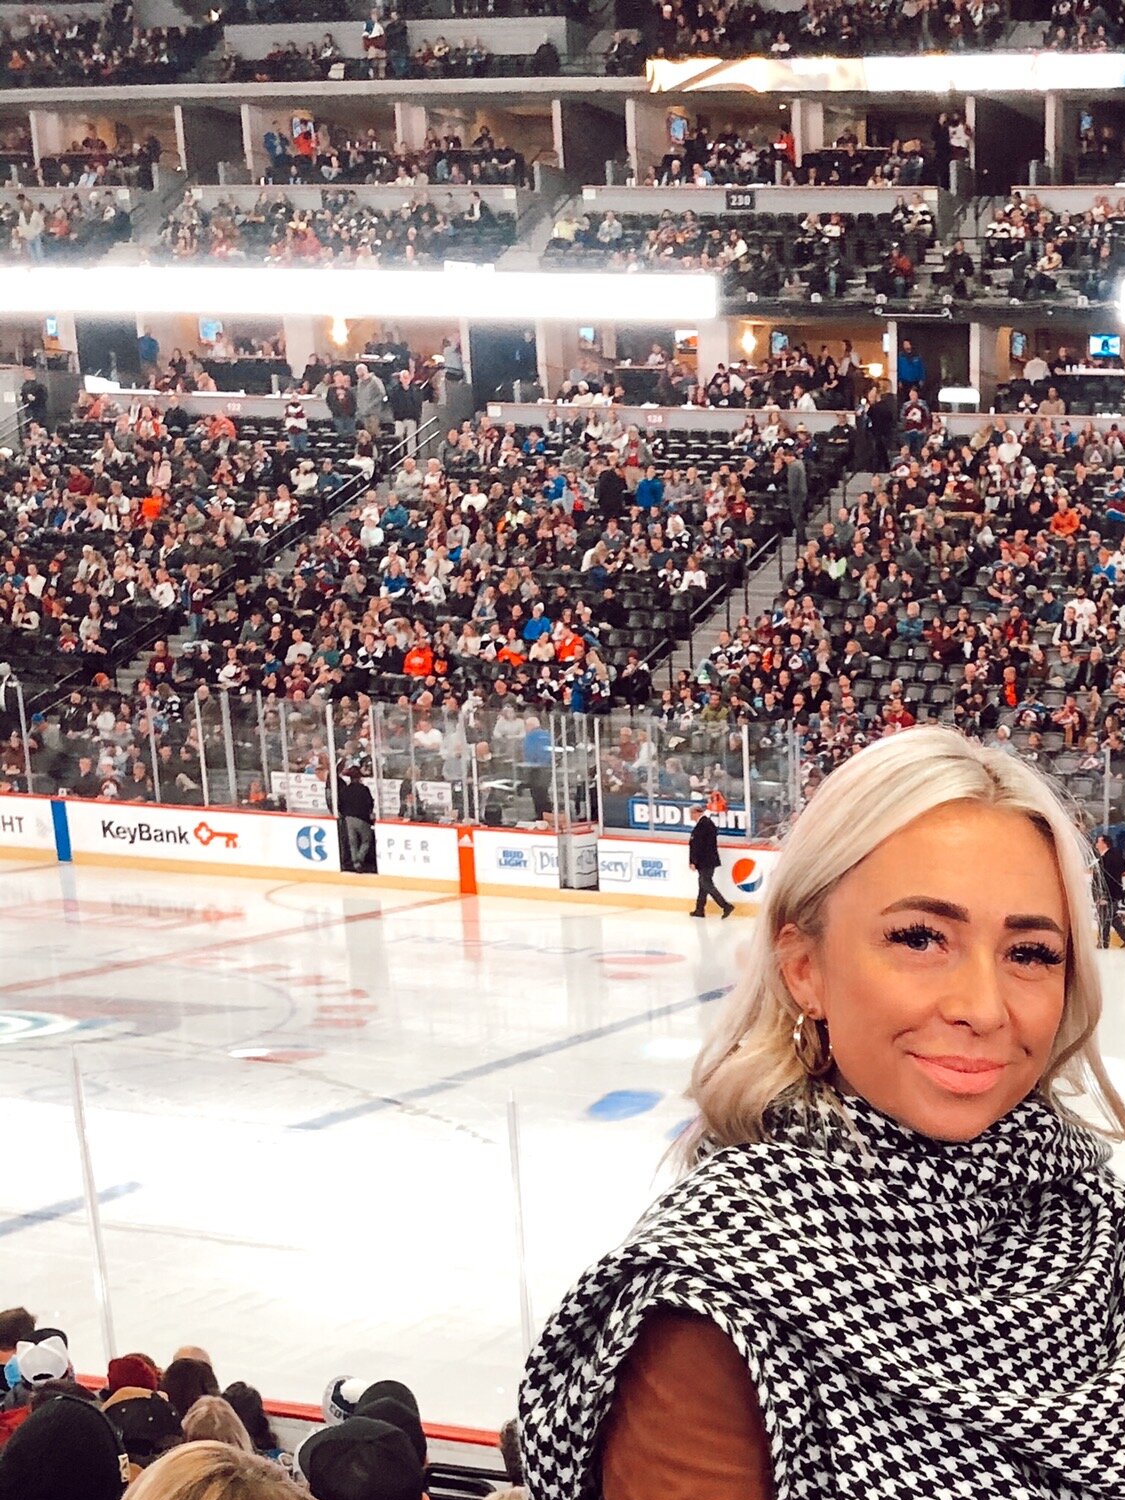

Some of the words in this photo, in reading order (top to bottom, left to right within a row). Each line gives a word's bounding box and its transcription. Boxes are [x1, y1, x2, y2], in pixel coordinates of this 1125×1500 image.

[634, 804, 681, 824] BUD
[682, 807, 746, 829] LHT
[101, 820, 190, 844] KeyBank
[502, 850, 524, 859] BUD
[499, 858, 527, 868] LIGHT
[641, 860, 663, 869] BUD
[637, 868, 667, 878] LIGHT
